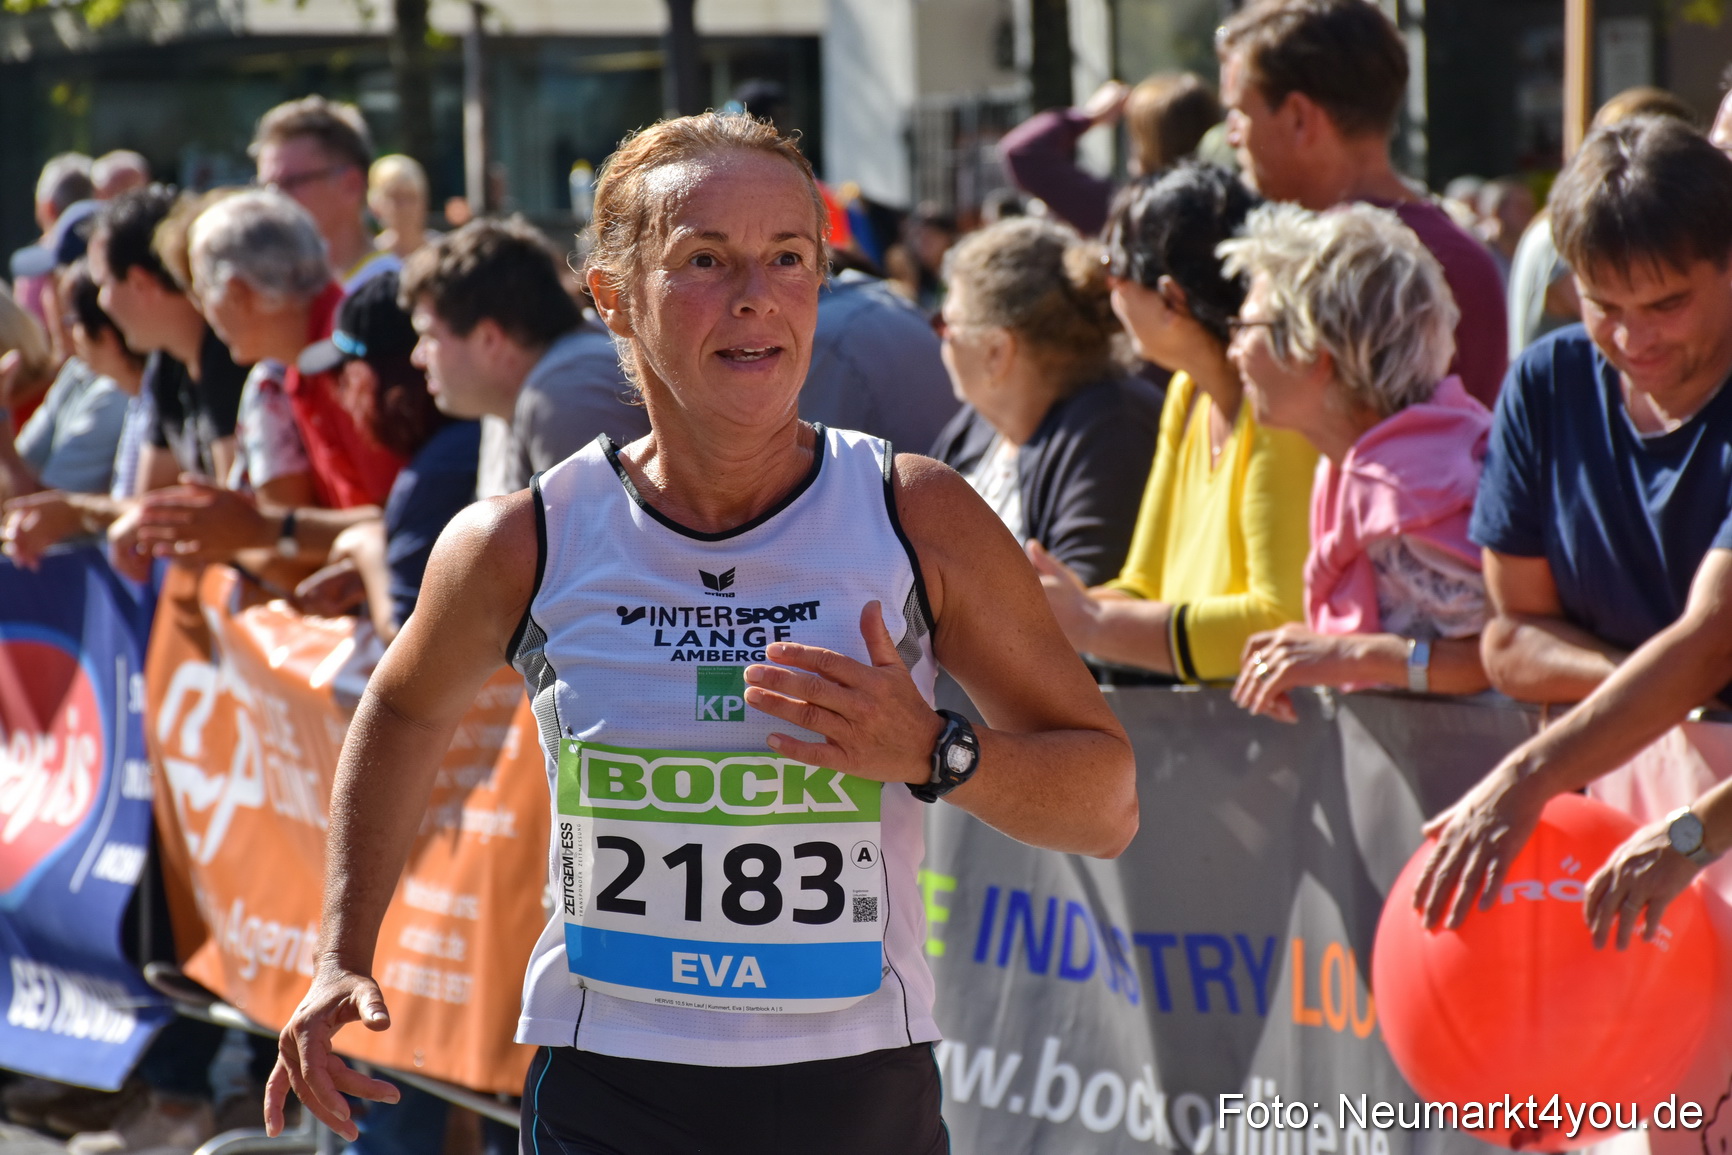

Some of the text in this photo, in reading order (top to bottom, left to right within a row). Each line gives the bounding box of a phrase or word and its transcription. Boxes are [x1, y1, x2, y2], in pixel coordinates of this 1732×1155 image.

[650, 600, 820, 628] INTERSPORT
[654, 625, 793, 648] LANGE
[670, 649, 767, 662] AMBERG
[697, 695, 744, 721] KP
[582, 757, 851, 813] BOCK
[857, 847, 872, 862] A
[596, 835, 846, 926] 2183
[672, 951, 767, 989] EVA
